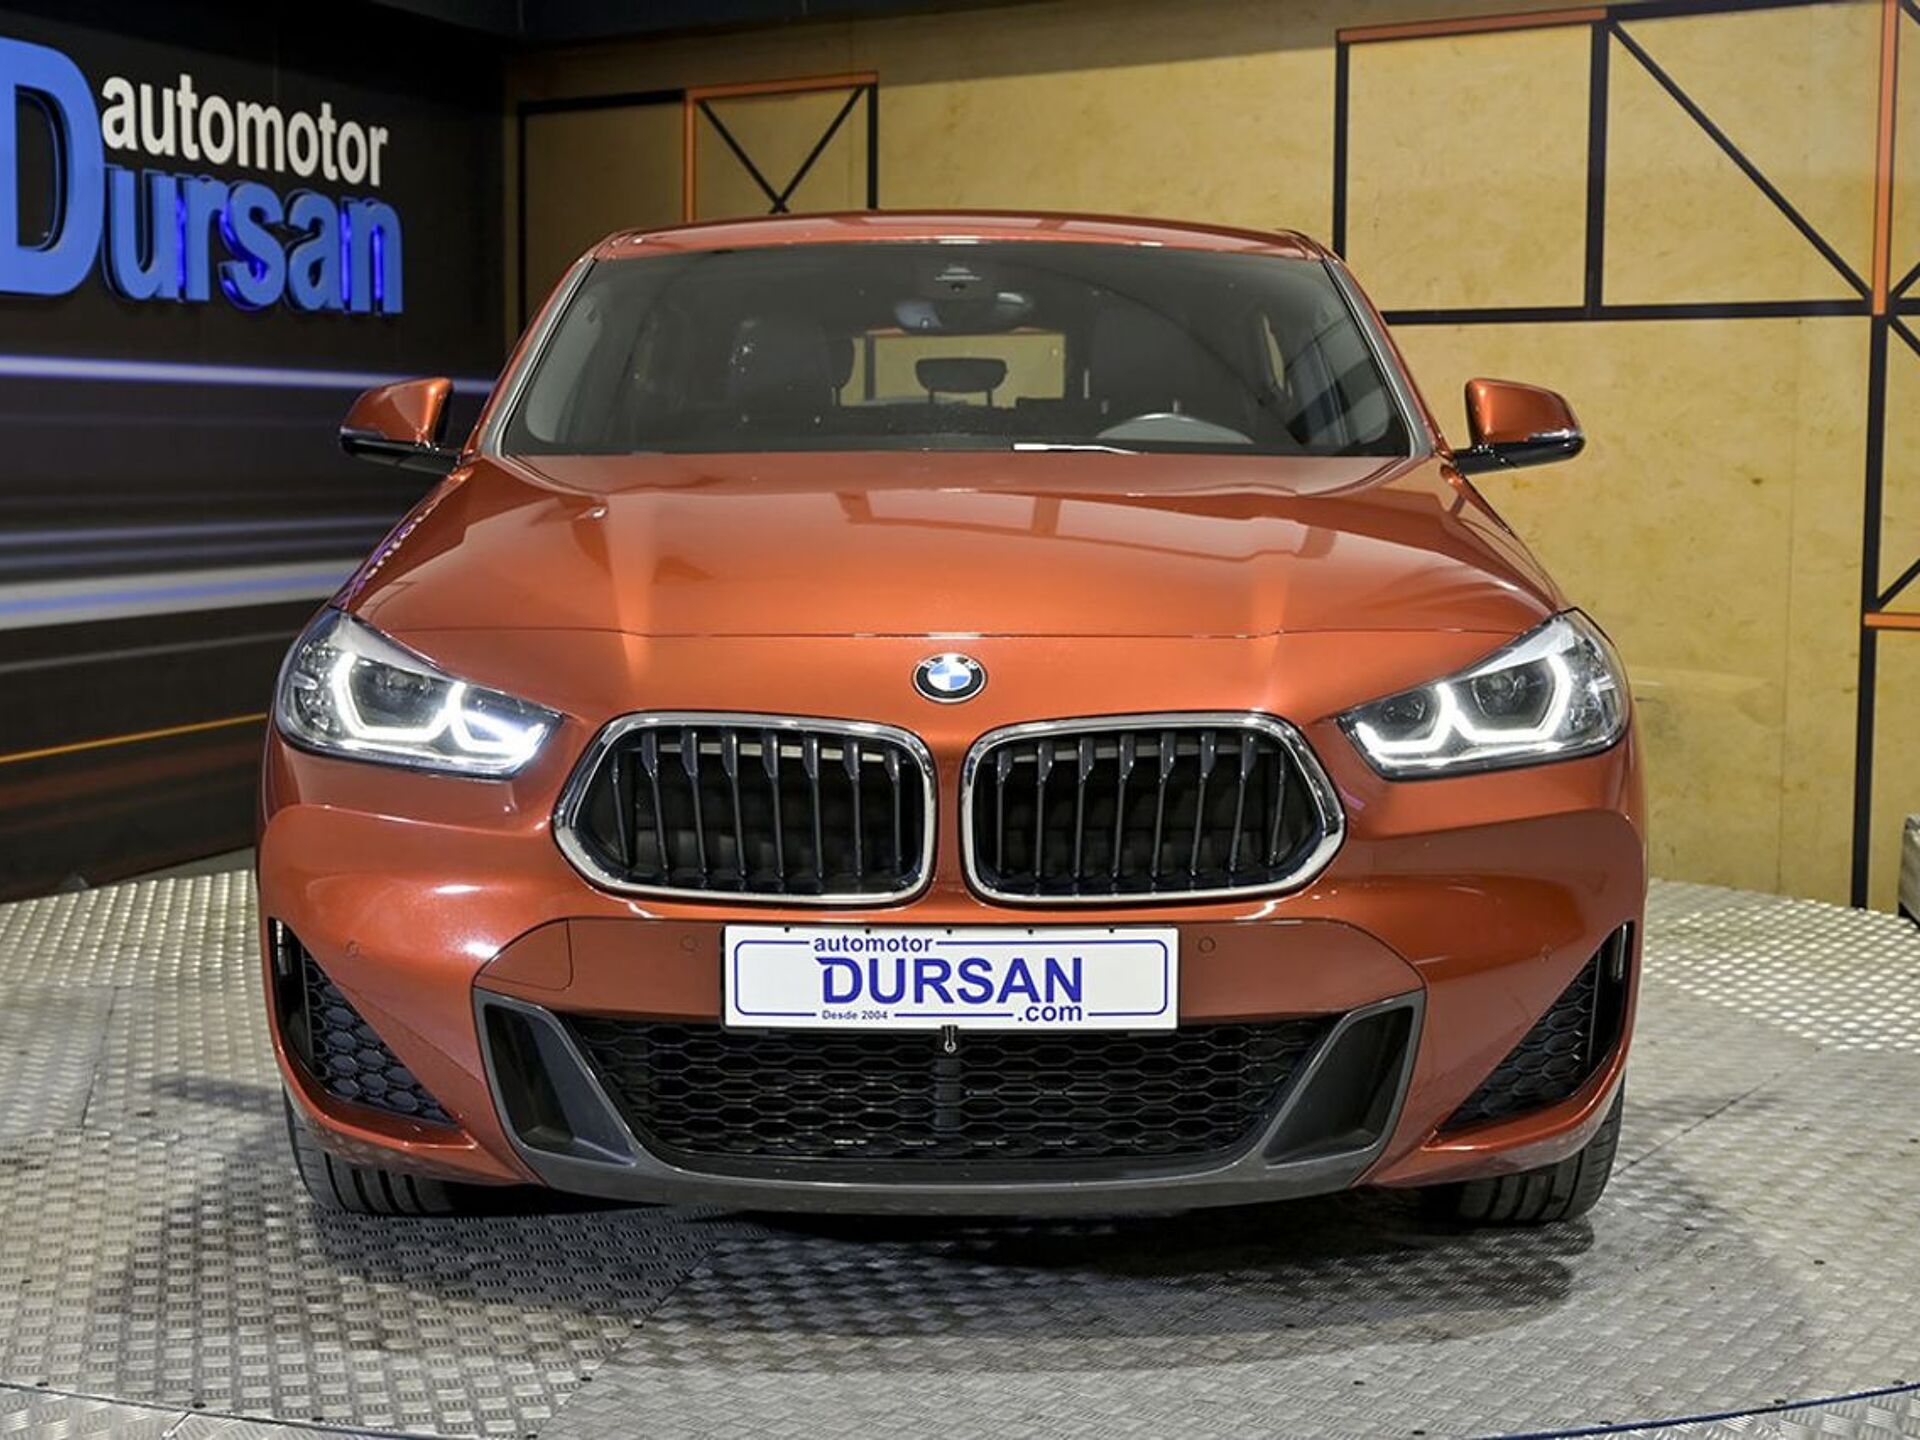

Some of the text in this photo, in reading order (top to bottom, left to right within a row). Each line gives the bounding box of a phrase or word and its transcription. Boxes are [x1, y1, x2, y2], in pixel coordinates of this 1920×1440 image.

[101, 73, 389, 187] automotor
[0, 36, 403, 314] Dursan
[813, 935, 934, 953] automotor
[815, 956, 1083, 1005] DURSAN
[822, 1009, 889, 1020] Desde 2004
[1017, 1003, 1083, 1022] .com
